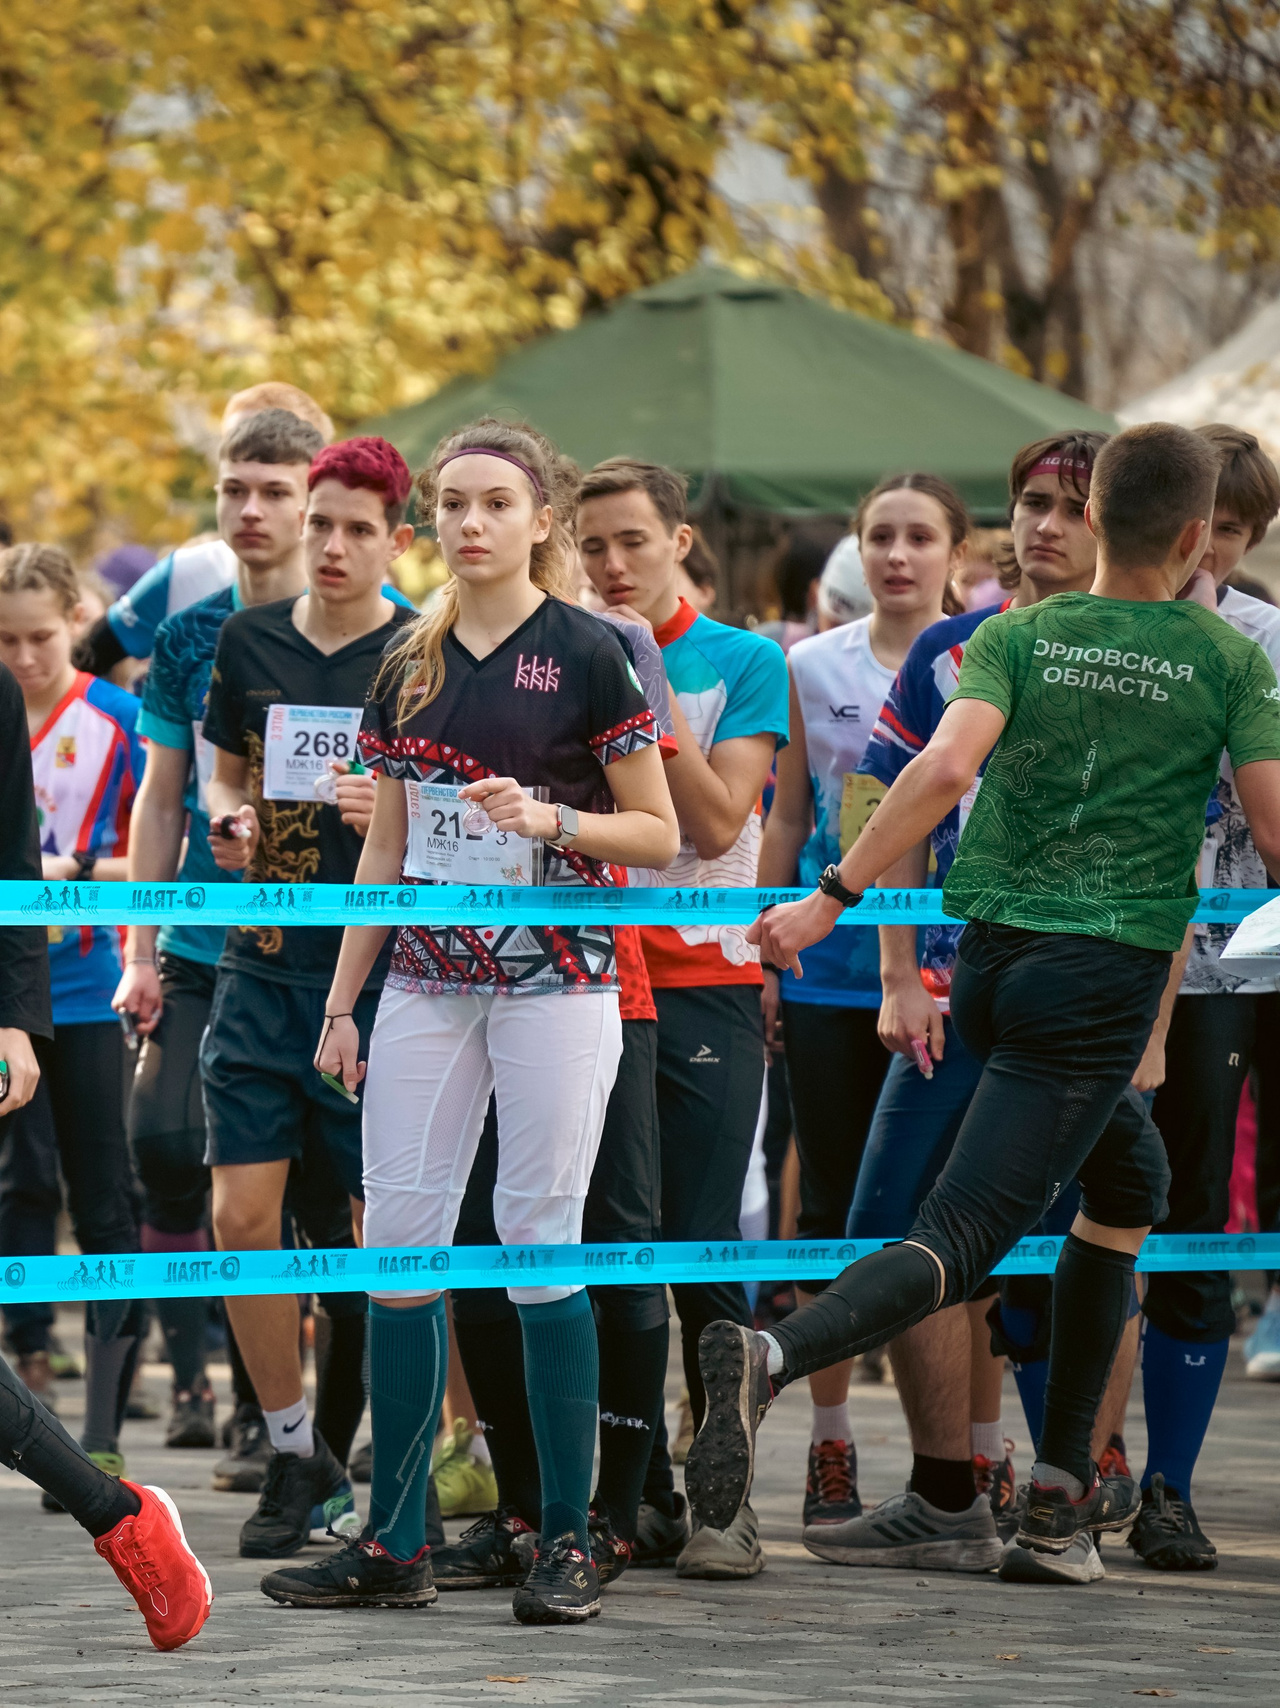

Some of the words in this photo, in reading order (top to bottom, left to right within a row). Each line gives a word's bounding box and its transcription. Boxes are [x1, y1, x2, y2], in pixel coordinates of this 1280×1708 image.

[1033, 638, 1195, 683] ОРЛОВСКАЯ
[1042, 666, 1170, 703] ОБЛАСТЬ
[293, 730, 350, 758] 268
[285, 759, 324, 770] МЖ16
[1080, 739, 1099, 797] VICTORY
[421, 785, 457, 798] ПЕРВЕНСТВО
[431, 809, 484, 841] 21
[496, 829, 508, 846] 3
[427, 837, 459, 852] МЖ16
